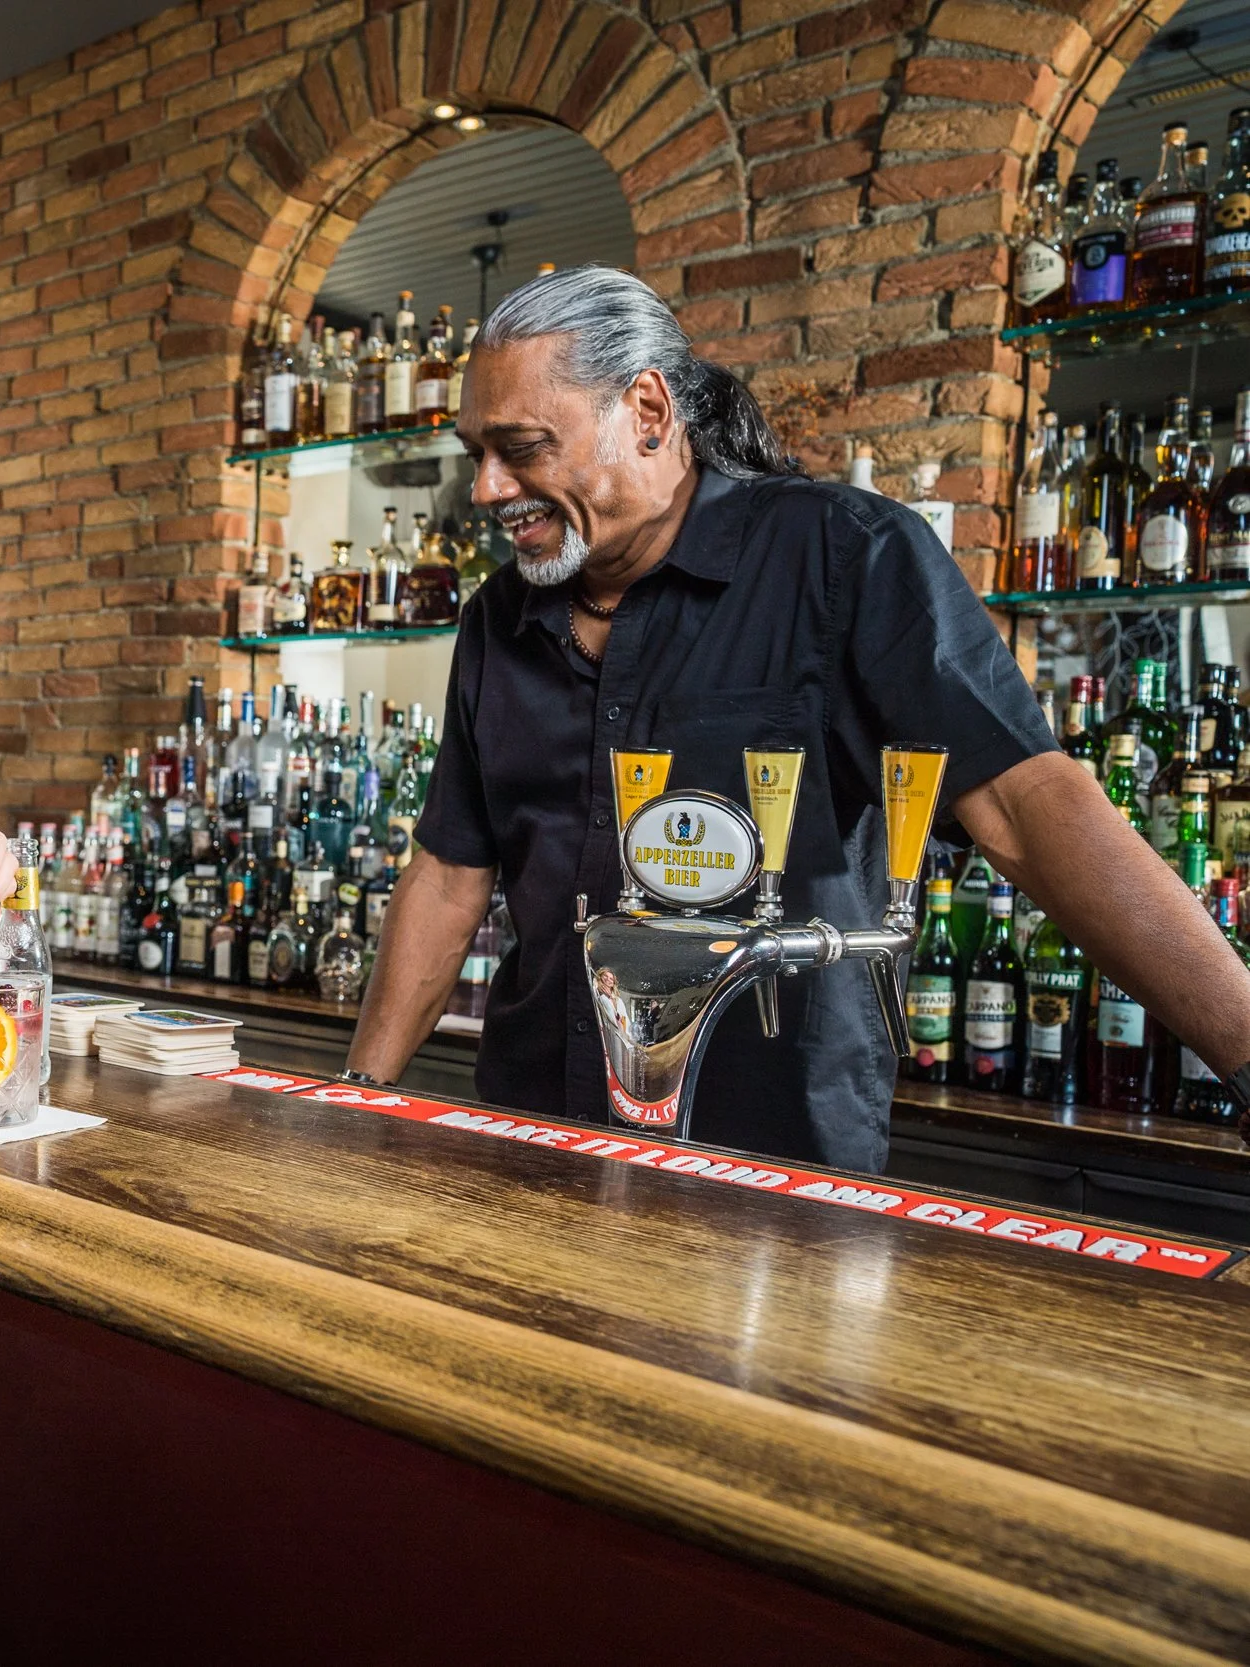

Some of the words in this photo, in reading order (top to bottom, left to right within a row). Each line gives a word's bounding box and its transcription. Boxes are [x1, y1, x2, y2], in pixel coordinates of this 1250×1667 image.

[634, 846, 736, 870] APPENZELLER
[664, 868, 701, 888] BIER
[1050, 973, 1081, 987] PRAT
[428, 1111, 581, 1146] MAKE
[571, 1138, 640, 1156] IT
[628, 1149, 790, 1188] LOUD
[788, 1181, 903, 1212] AND
